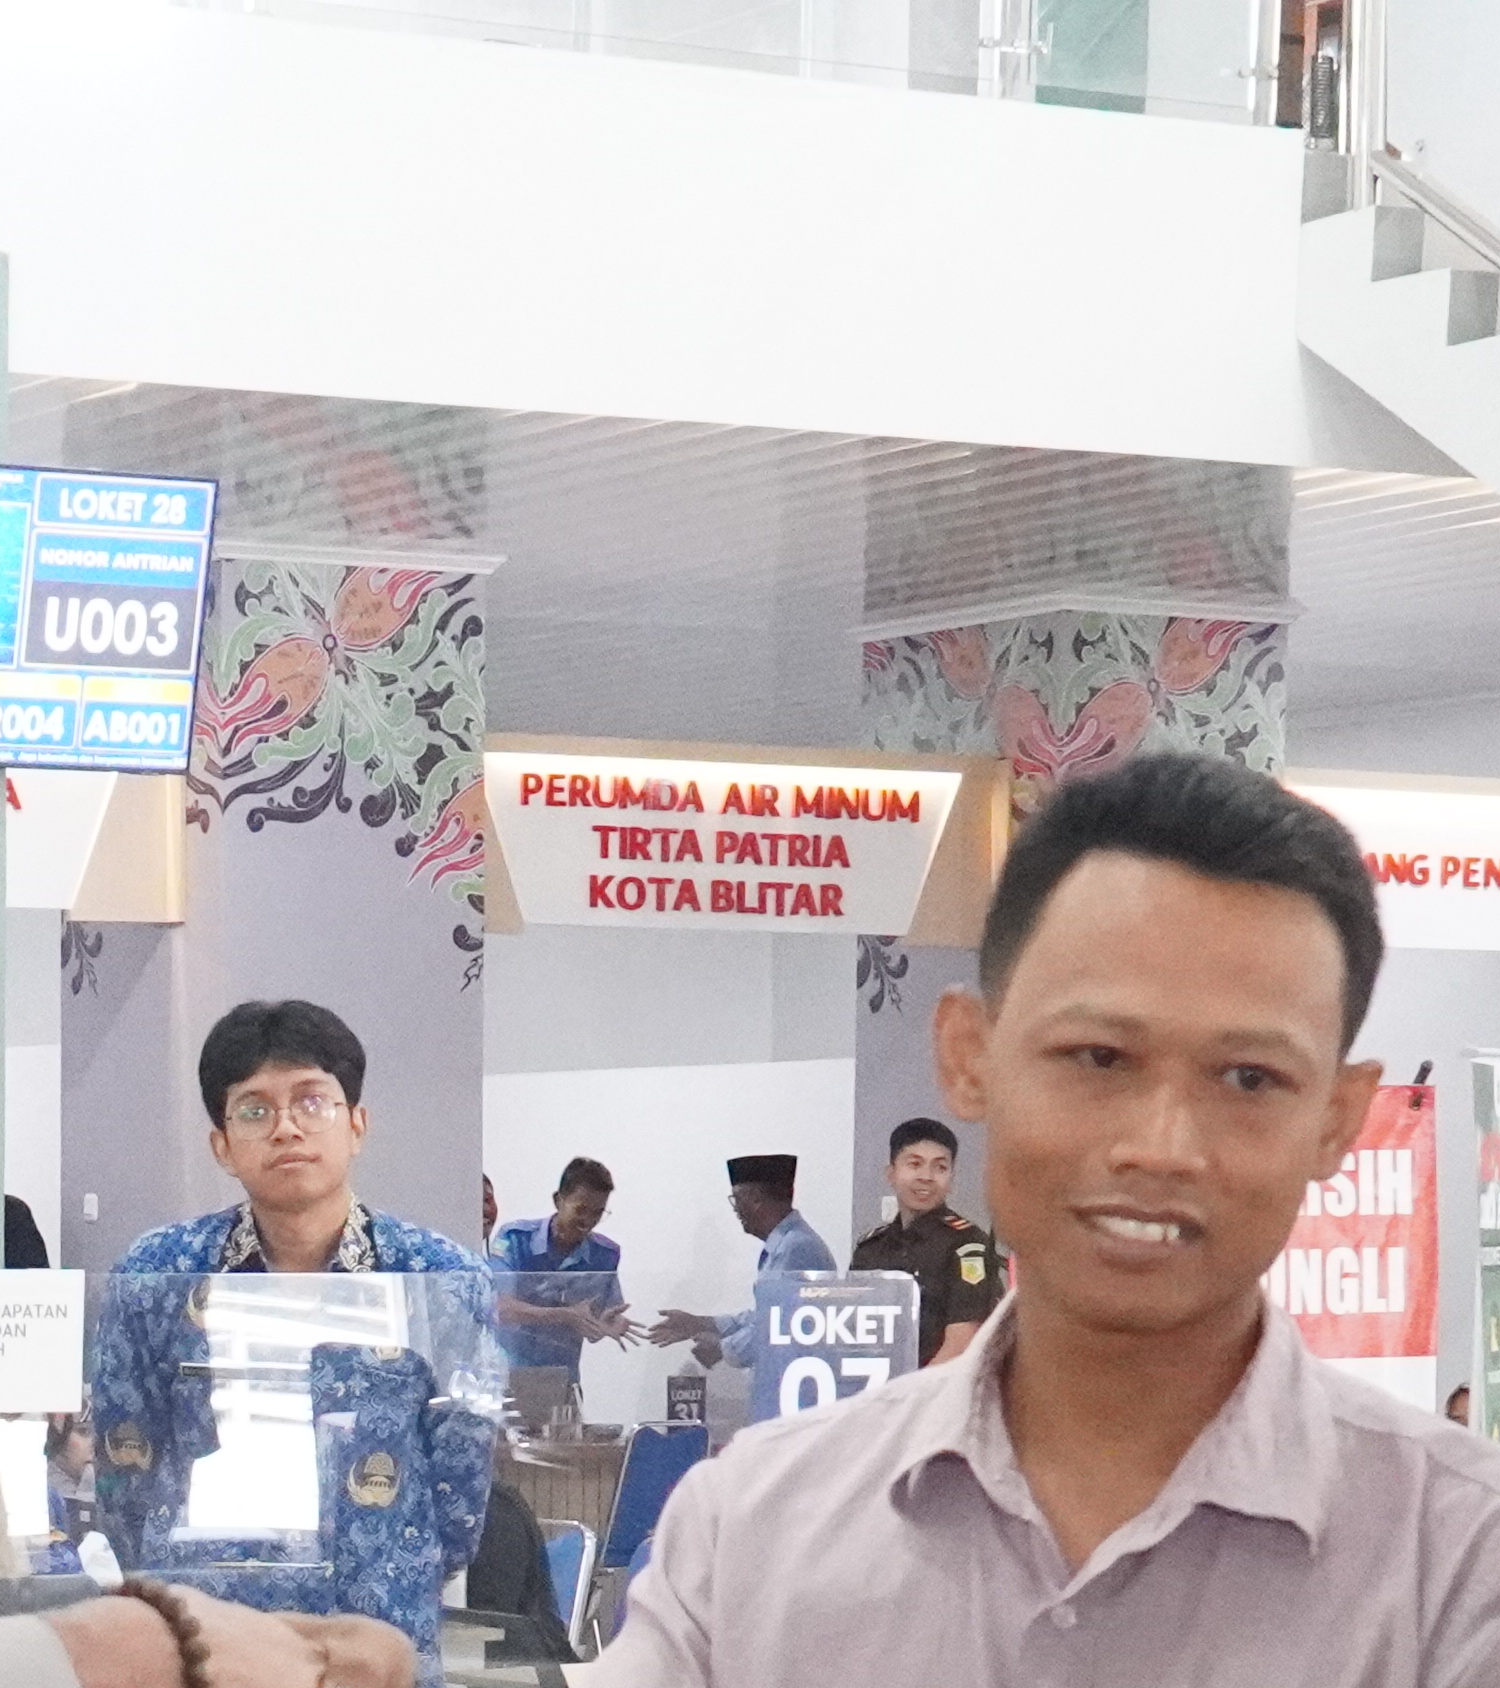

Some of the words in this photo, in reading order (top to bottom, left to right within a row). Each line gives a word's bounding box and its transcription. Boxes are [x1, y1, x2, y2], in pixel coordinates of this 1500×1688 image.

[59, 488, 147, 522] LOKET
[151, 493, 187, 525] 28
[40, 548, 110, 568] NOMOR
[112, 552, 194, 572] ANTRIAN
[44, 596, 179, 657] U003
[83, 709, 181, 745] AB001
[520, 773, 704, 813] PERUMDA
[721, 783, 780, 817] AIR
[793, 785, 921, 822] MINUM
[592, 825, 703, 864] TIRTA
[715, 831, 851, 868] PATRIA
[589, 875, 701, 912] KOTA
[710, 880, 844, 917] BLITAR
[769, 1305, 902, 1345] LOKET
[670, 1389, 704, 1401] LOKET
